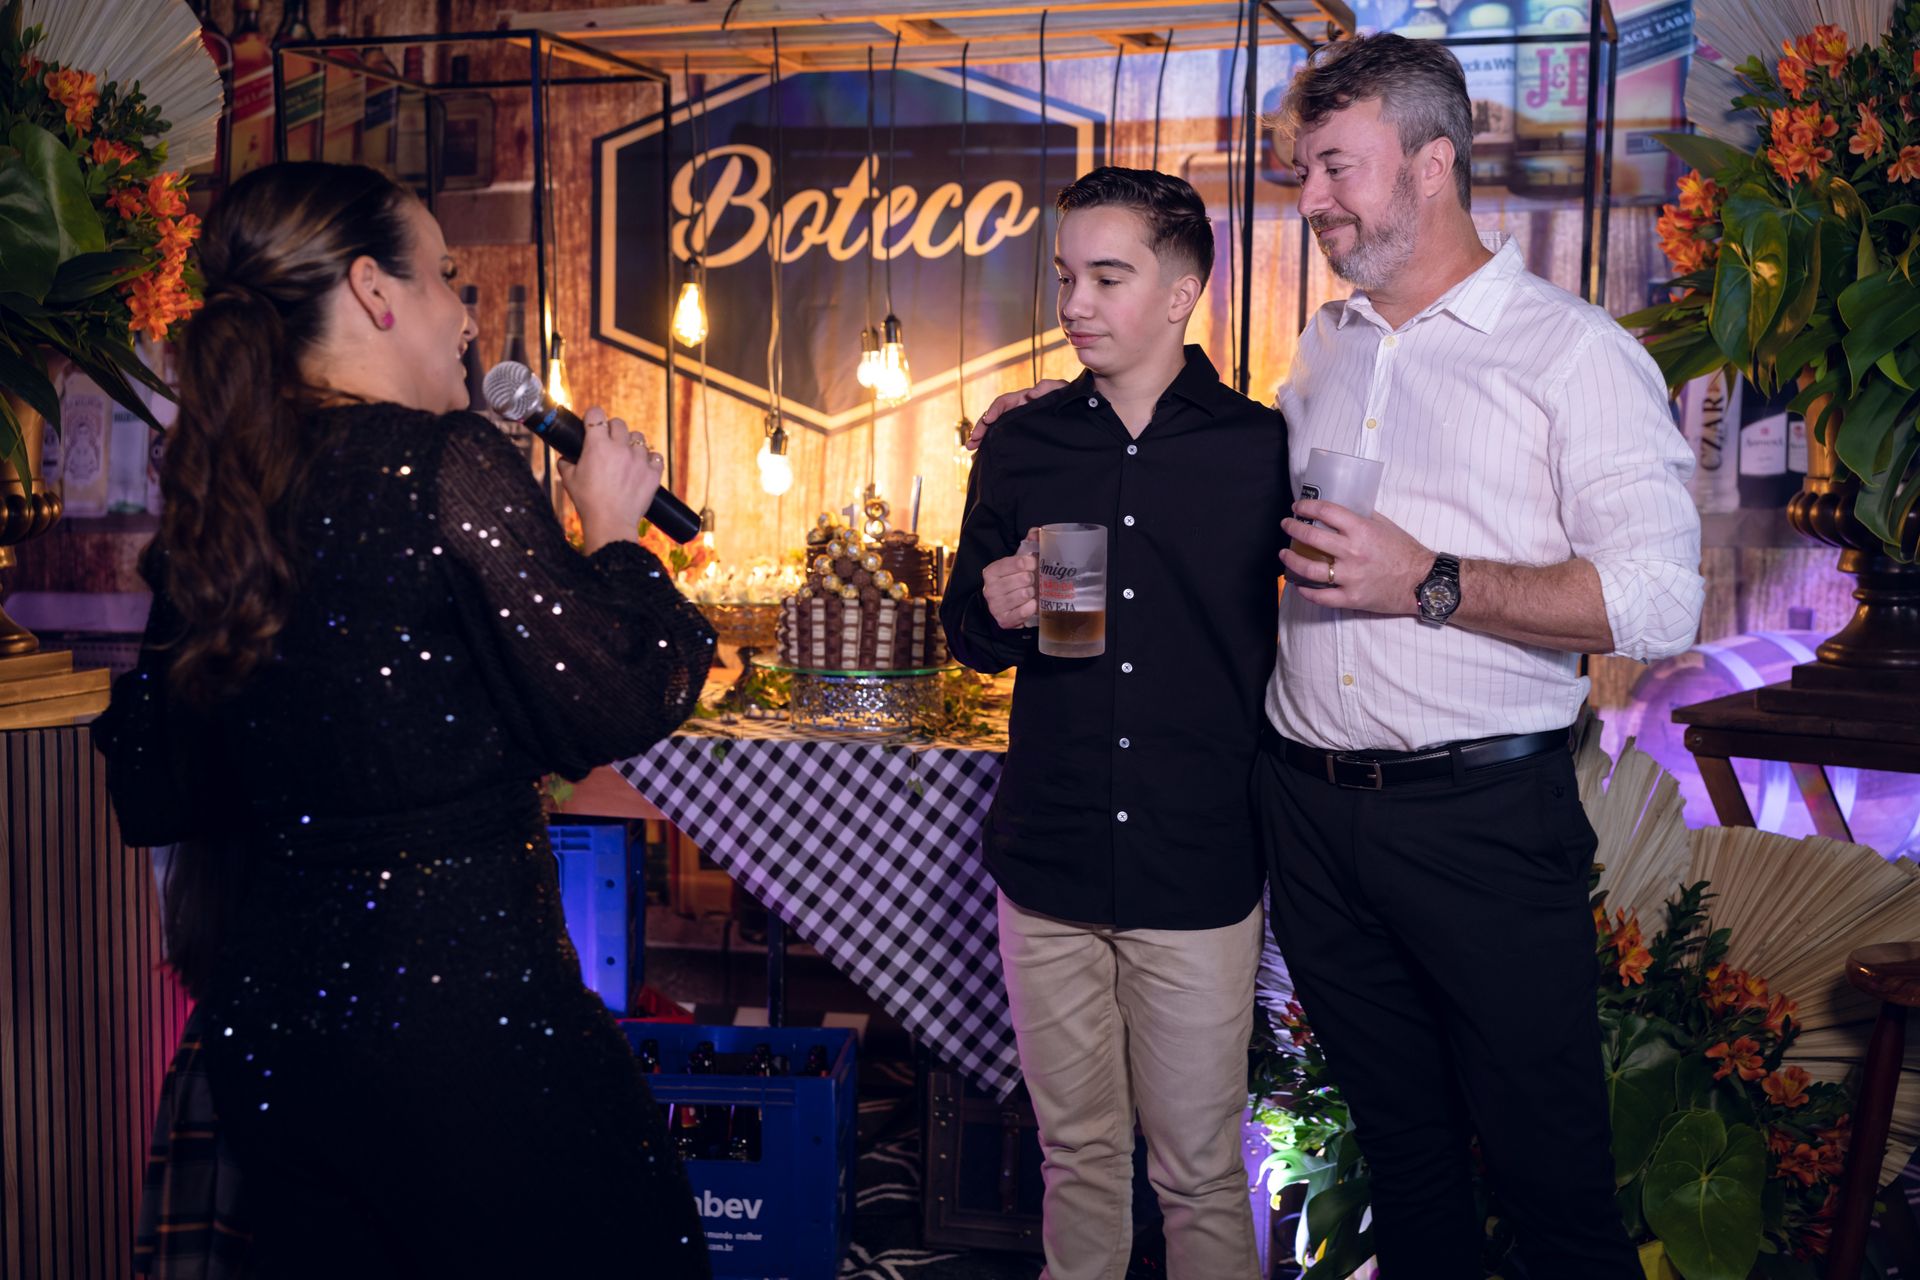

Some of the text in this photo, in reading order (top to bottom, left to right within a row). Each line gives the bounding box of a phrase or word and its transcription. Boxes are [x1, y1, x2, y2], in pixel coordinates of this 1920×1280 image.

[1618, 27, 1653, 48] ACK
[1655, 12, 1692, 34] LABE
[671, 144, 1040, 268] Boteco
[1701, 396, 1725, 471] CZAR
[1040, 599, 1076, 613] ERVEJA
[694, 1189, 763, 1220] bev
[707, 1243, 734, 1252] com.br
[735, 1232, 763, 1241] melhor
